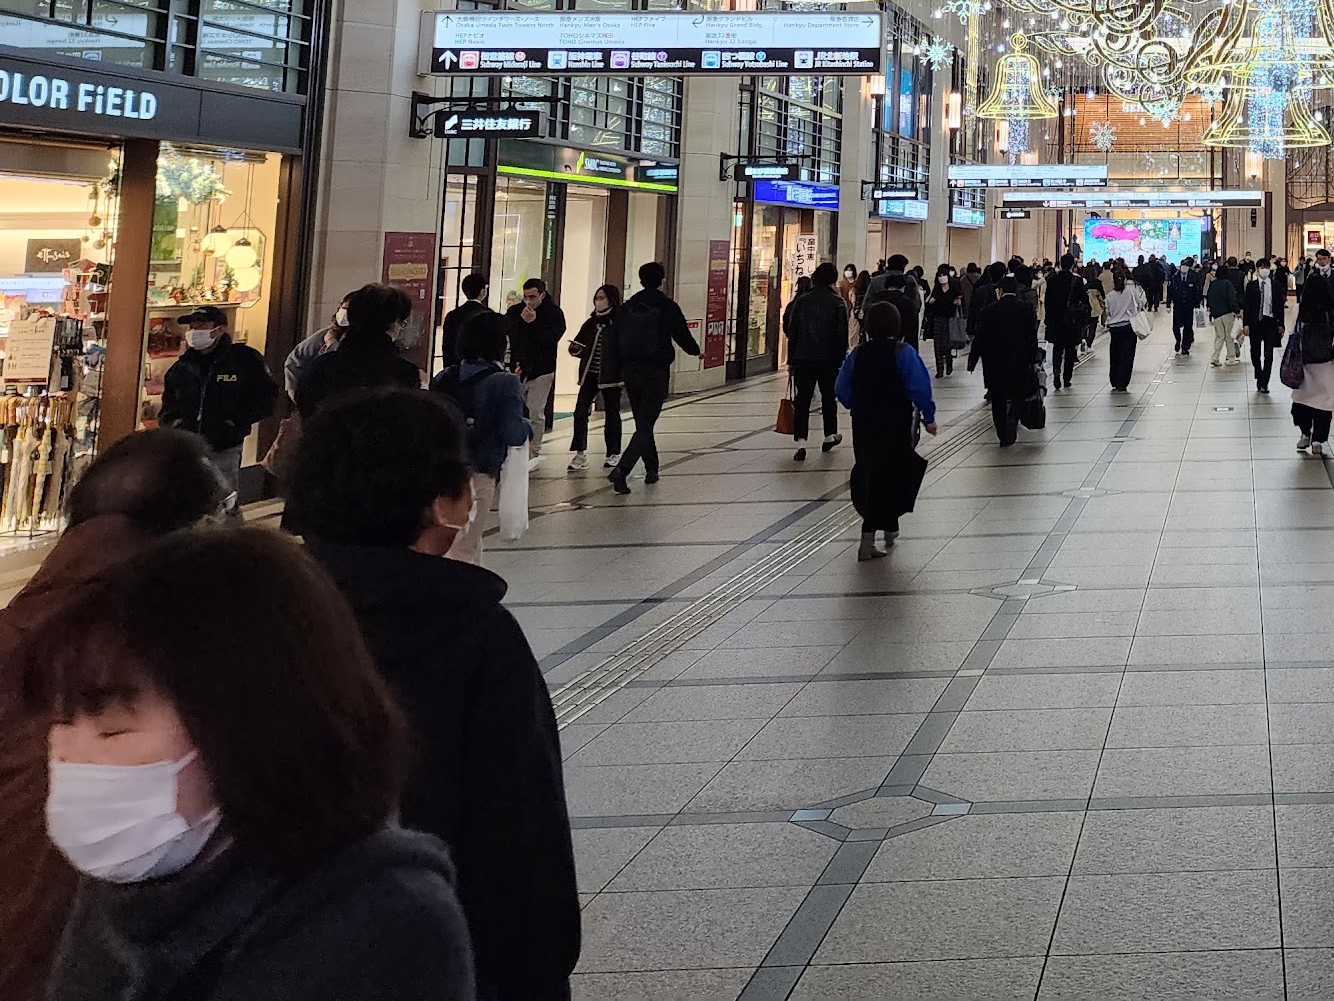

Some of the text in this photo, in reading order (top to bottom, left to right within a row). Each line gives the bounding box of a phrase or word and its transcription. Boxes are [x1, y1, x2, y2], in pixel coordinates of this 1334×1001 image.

[529, 60, 542, 68] Line
[776, 60, 788, 68] Line
[461, 117, 532, 131] 三井住友銀行
[216, 374, 238, 382] FILA
